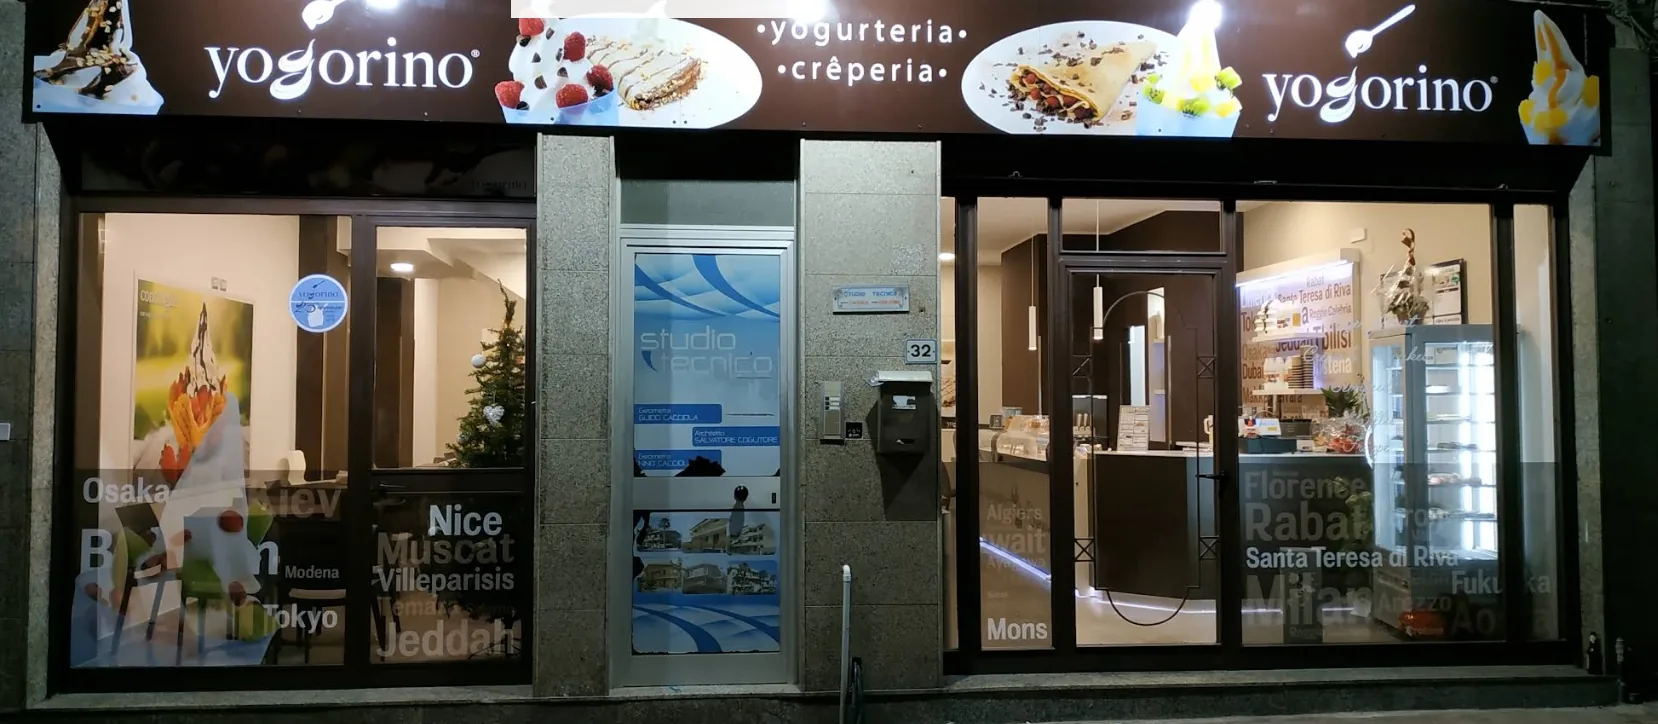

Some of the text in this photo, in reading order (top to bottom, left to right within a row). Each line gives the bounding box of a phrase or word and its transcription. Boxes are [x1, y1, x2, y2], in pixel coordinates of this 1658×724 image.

[770, 19, 953, 46] yogurteria
[204, 37, 473, 100] yogorino
[791, 56, 933, 87] crêperia
[1262, 64, 1493, 123] yogorino
[1299, 289, 1323, 304] Teresa
[1325, 285, 1332, 299] di
[1333, 283, 1351, 298] Riva
[640, 325, 736, 350] studio
[910, 344, 932, 358] 32
[82, 476, 171, 504] Osaka
[428, 503, 503, 537] Nice
[986, 503, 1043, 525] Algiers
[377, 531, 515, 566] Muscat
[1245, 545, 1459, 569] Santa Teresa di Riva
[285, 564, 340, 579] Modena
[377, 566, 515, 596] Villeparisis
[1379, 591, 1452, 613] Arzzo
[263, 603, 338, 634] Tokyo
[987, 617, 1048, 641] Mons
[376, 618, 515, 658] Jeddah
